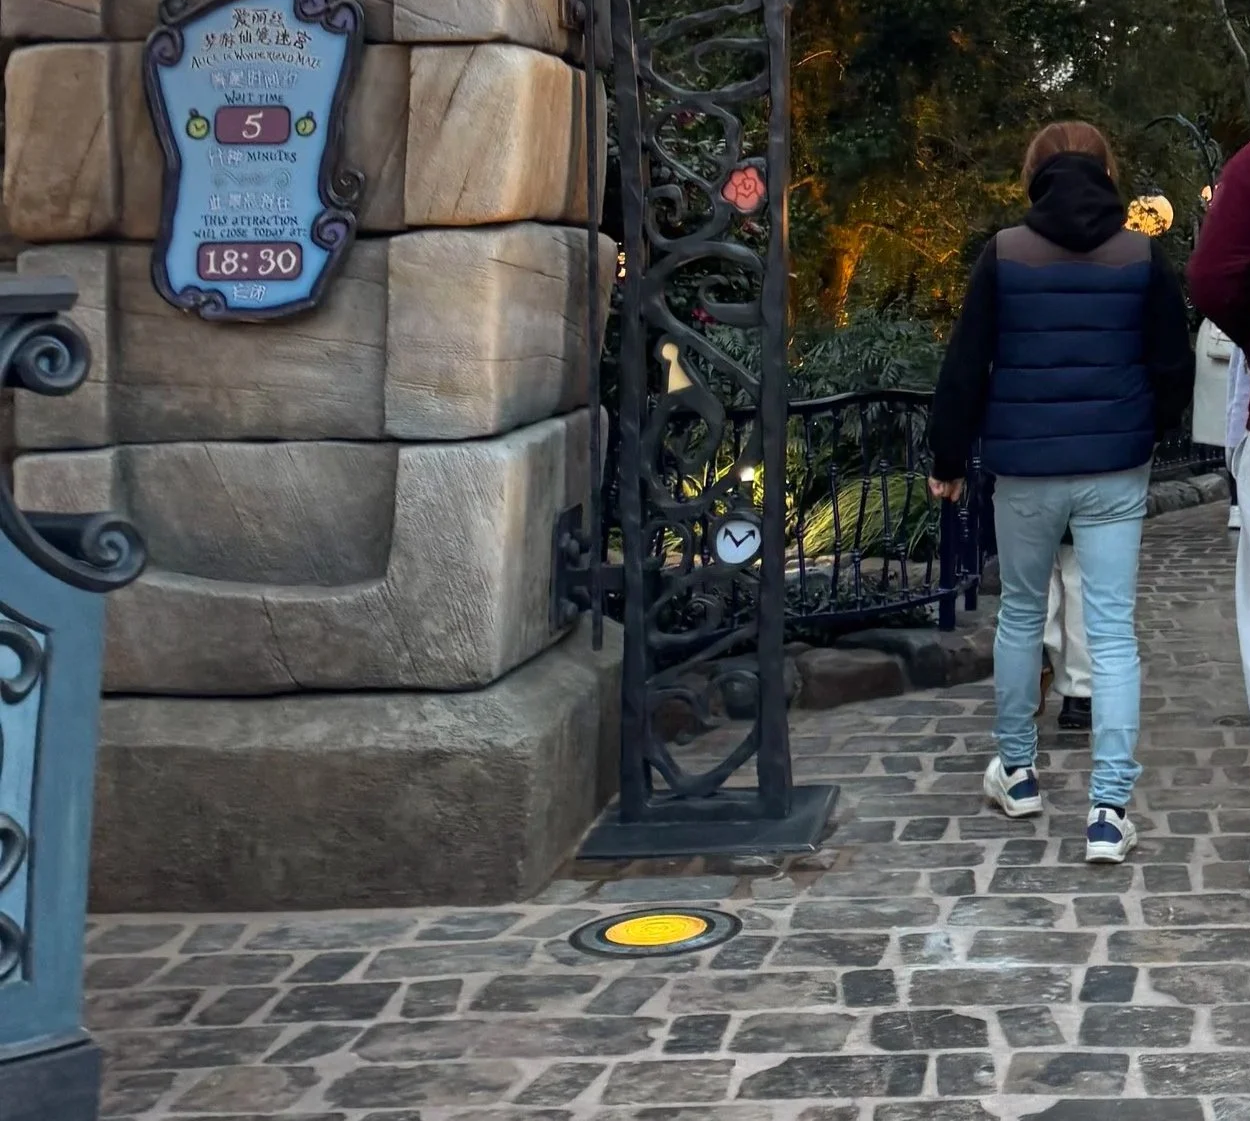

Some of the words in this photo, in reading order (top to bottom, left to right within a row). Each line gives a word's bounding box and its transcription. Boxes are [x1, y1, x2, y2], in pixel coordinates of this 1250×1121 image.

[232, 7, 285, 29] 爱丽丝
[204, 27, 312, 51] 梦游仙境迷宫
[242, 111, 263, 139] 5
